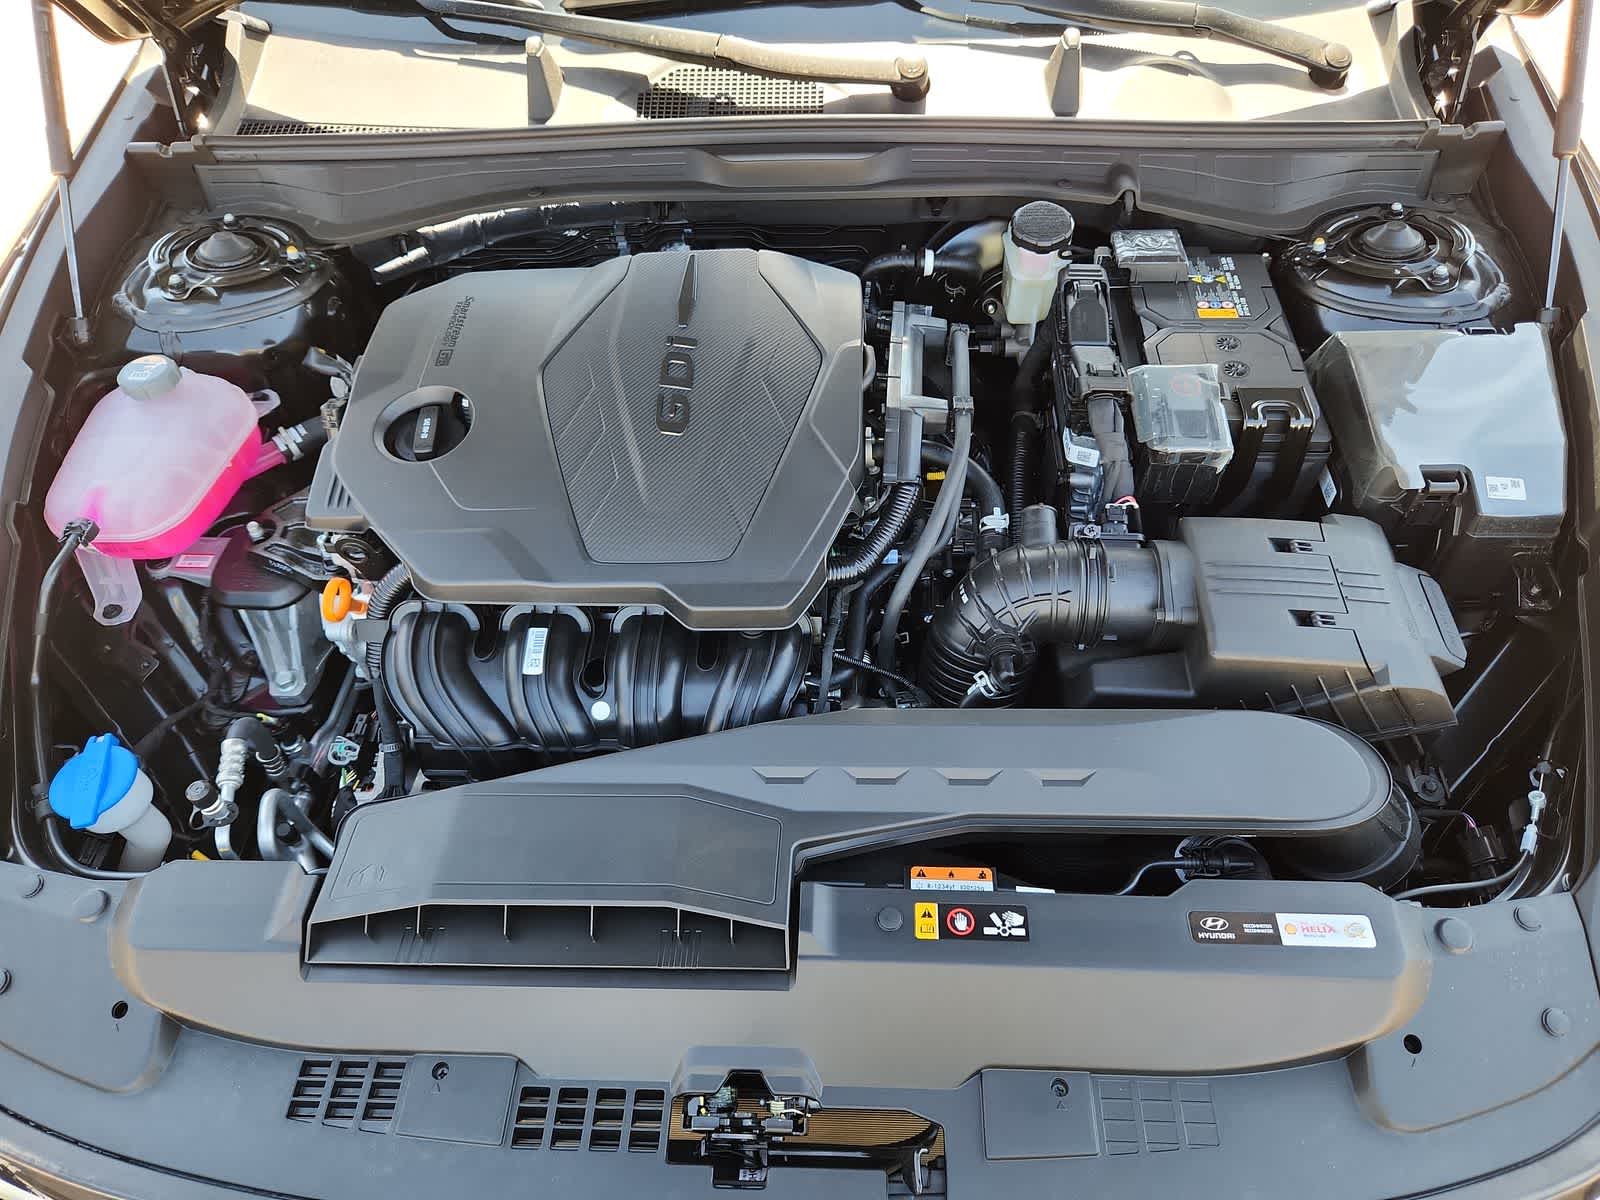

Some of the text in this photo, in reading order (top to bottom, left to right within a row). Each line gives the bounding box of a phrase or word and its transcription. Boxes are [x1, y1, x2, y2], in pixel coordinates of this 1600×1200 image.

[448, 296, 475, 348] Smartstream
[1302, 924, 1337, 934] HELIX
[1198, 932, 1236, 940] HYUNDAI
